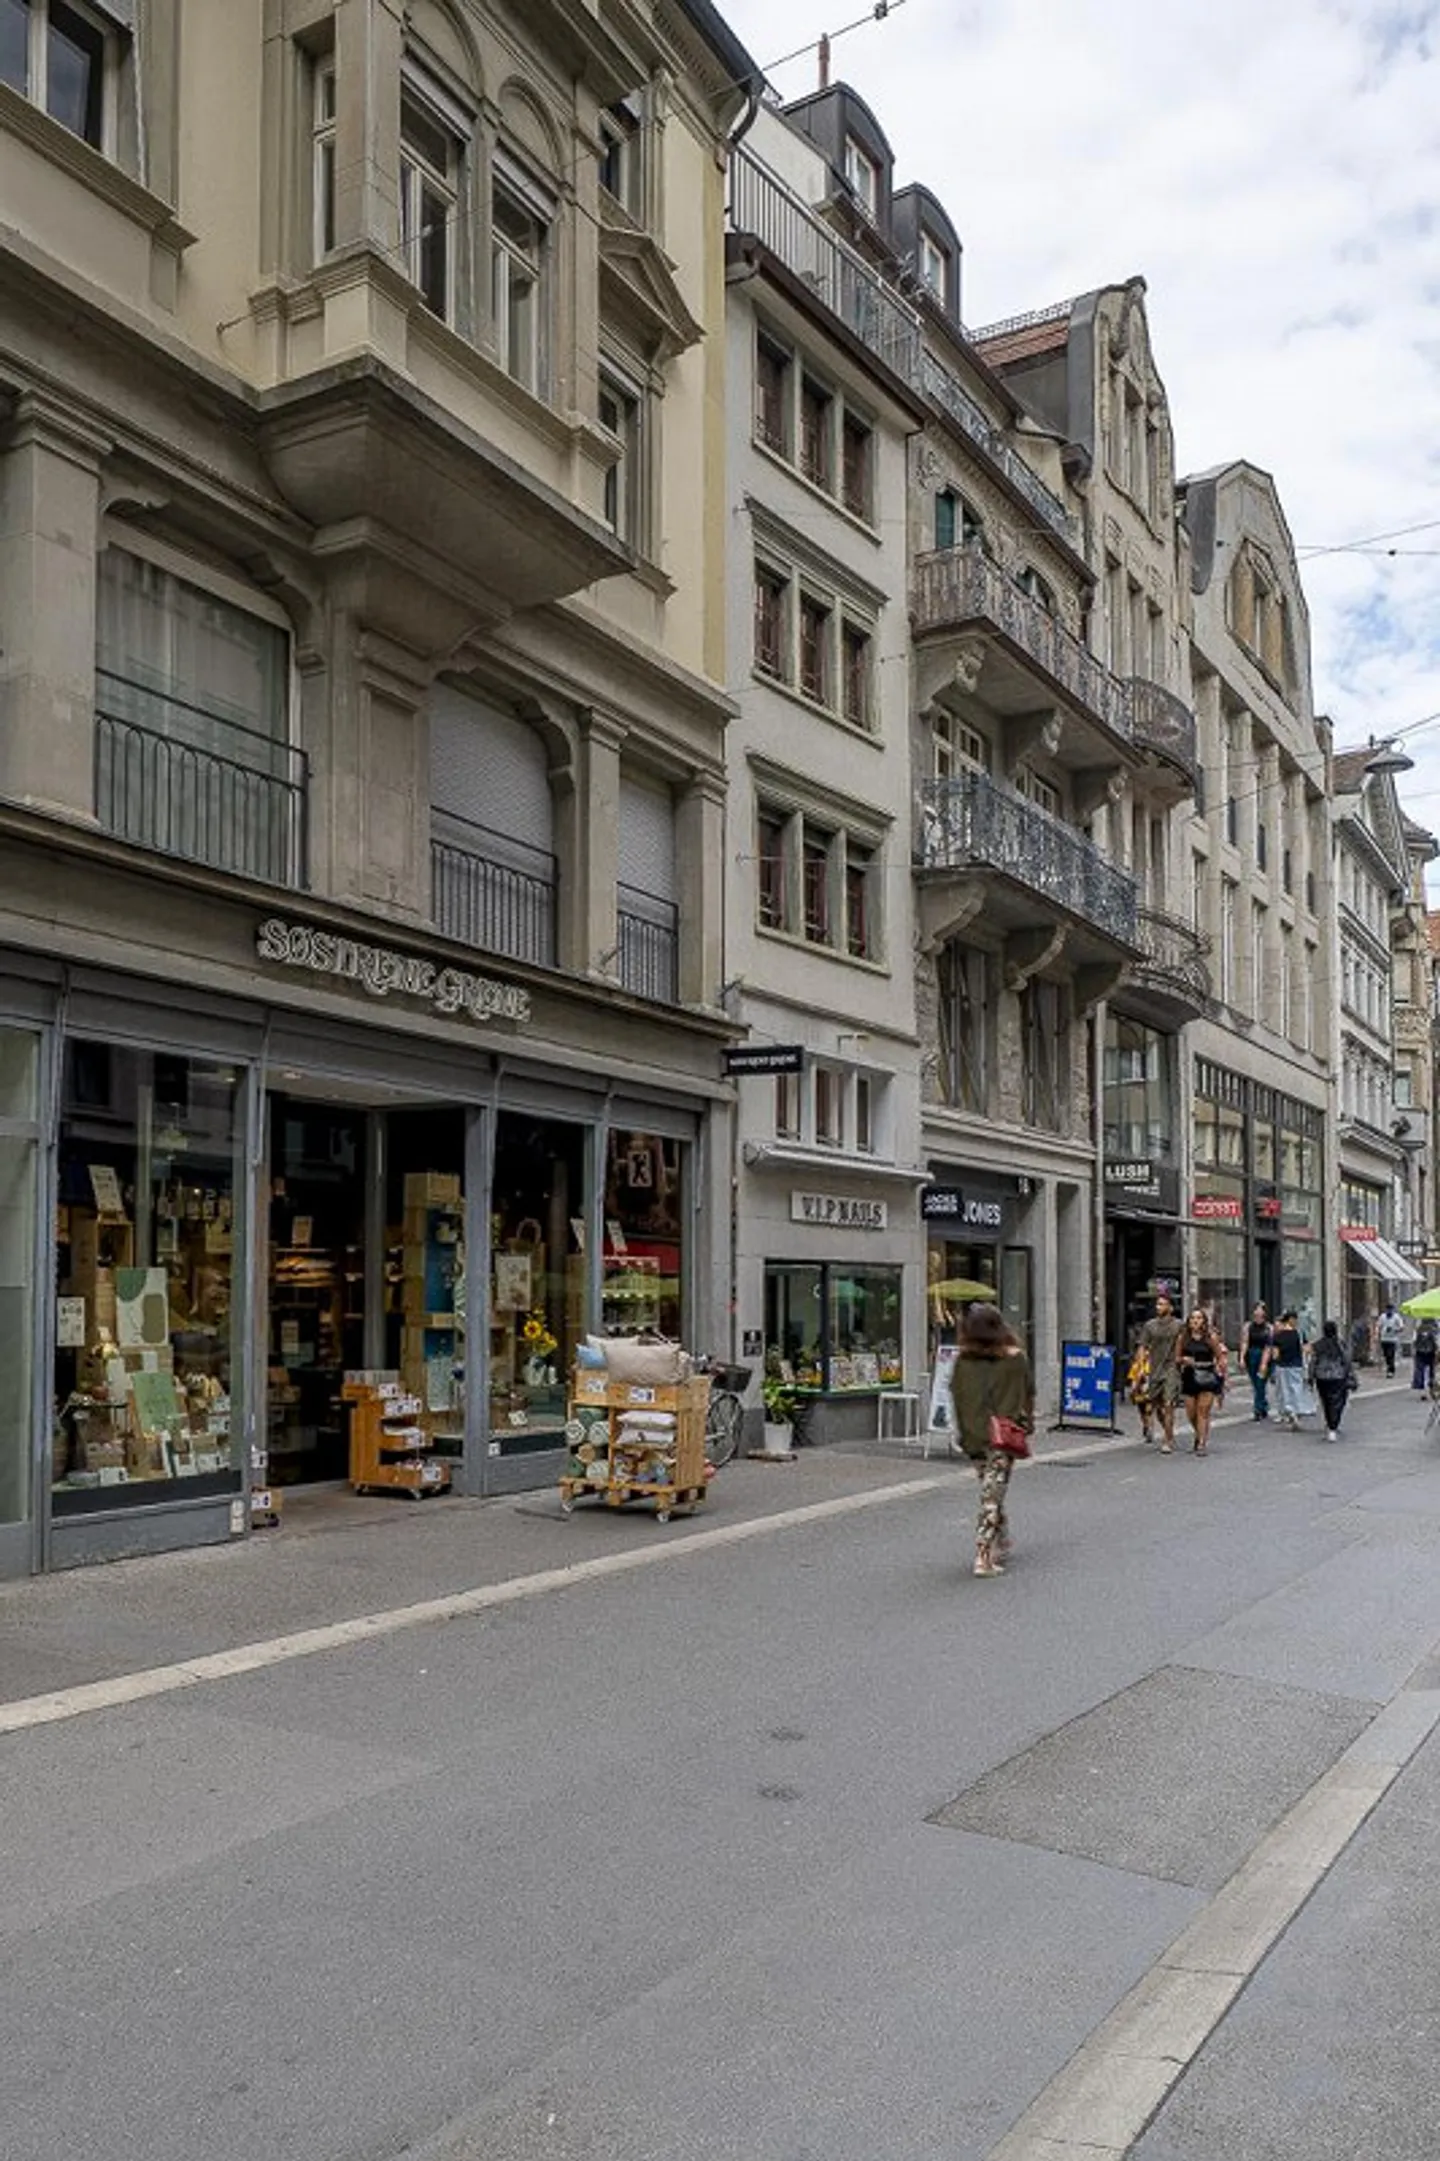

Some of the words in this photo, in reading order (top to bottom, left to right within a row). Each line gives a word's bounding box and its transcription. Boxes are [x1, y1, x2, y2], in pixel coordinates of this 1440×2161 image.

[433, 966, 532, 1023] GRENE
[1105, 1164, 1149, 1178] LUSH
[838, 1200, 883, 1225] NAILS
[962, 1201, 1002, 1225] JONES
